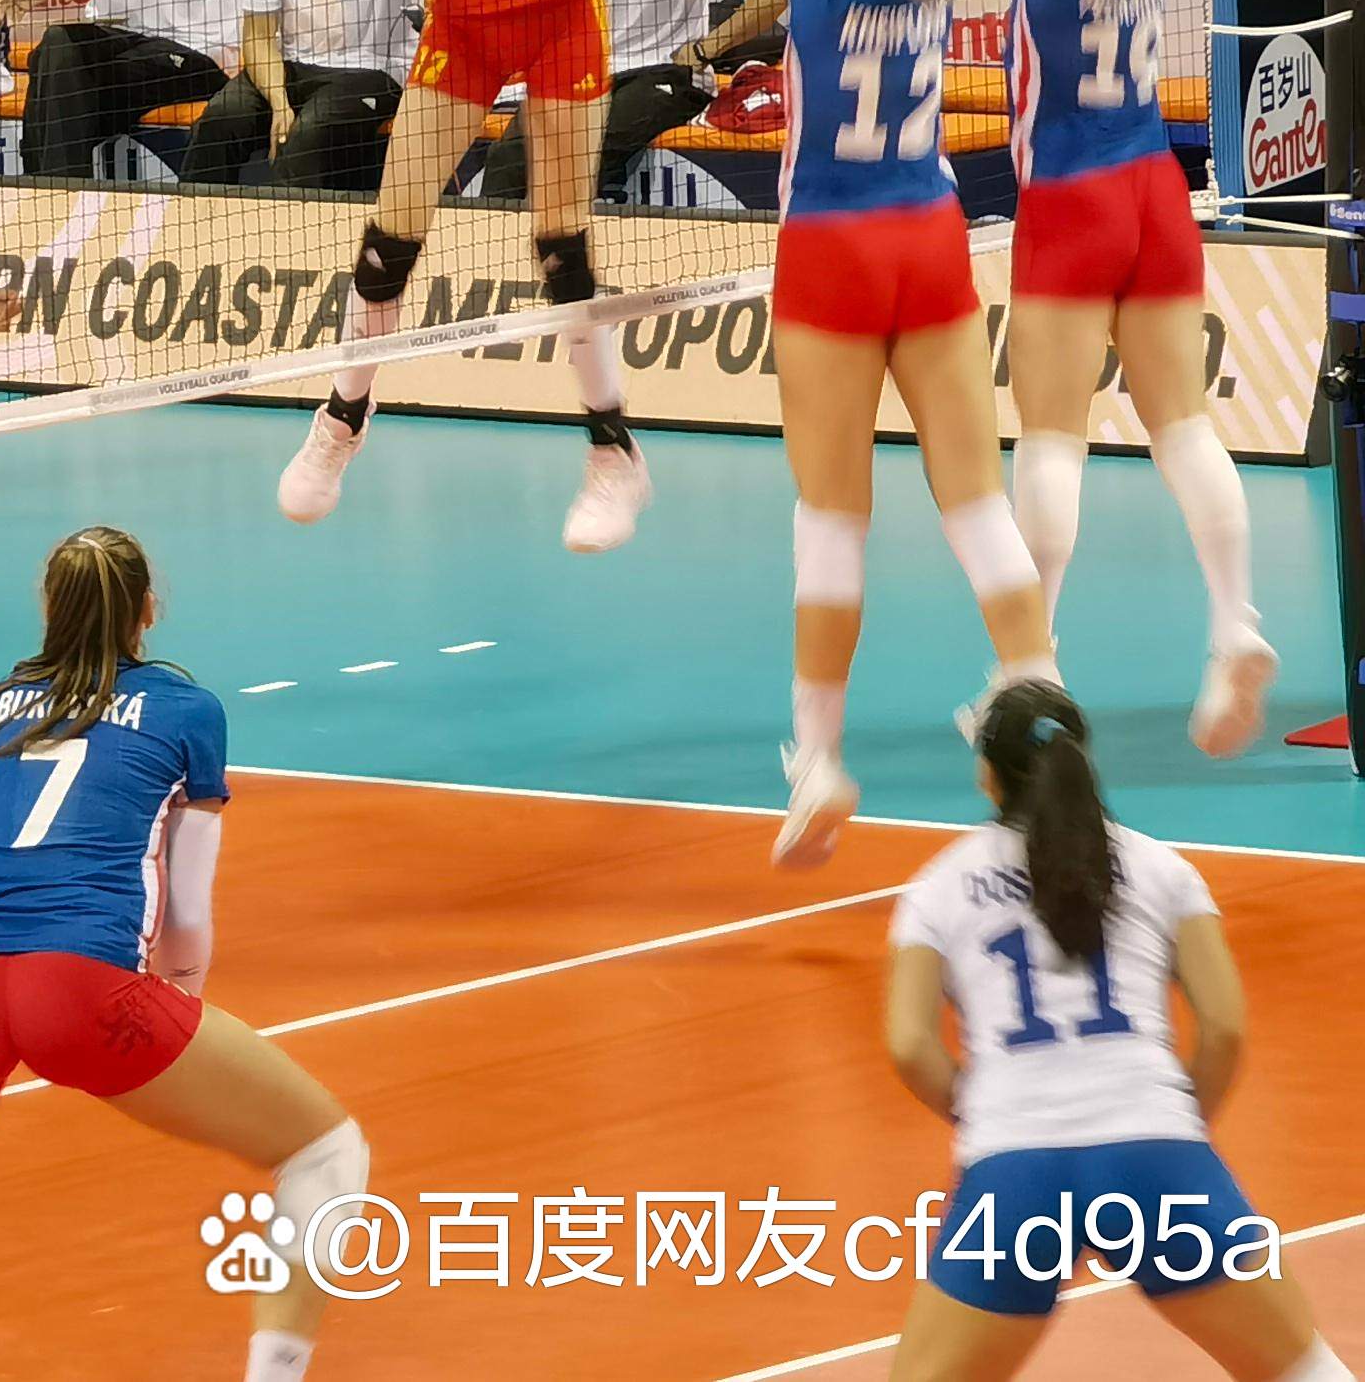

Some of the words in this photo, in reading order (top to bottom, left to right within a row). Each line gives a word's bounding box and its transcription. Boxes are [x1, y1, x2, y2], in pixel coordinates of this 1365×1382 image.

[1259, 51, 1312, 115] 百岁山
[87, 256, 356, 351] COASTA
[159, 375, 209, 395] VOLLEYBALL
[12, 739, 88, 848] 7
[987, 925, 1133, 1046] 11
